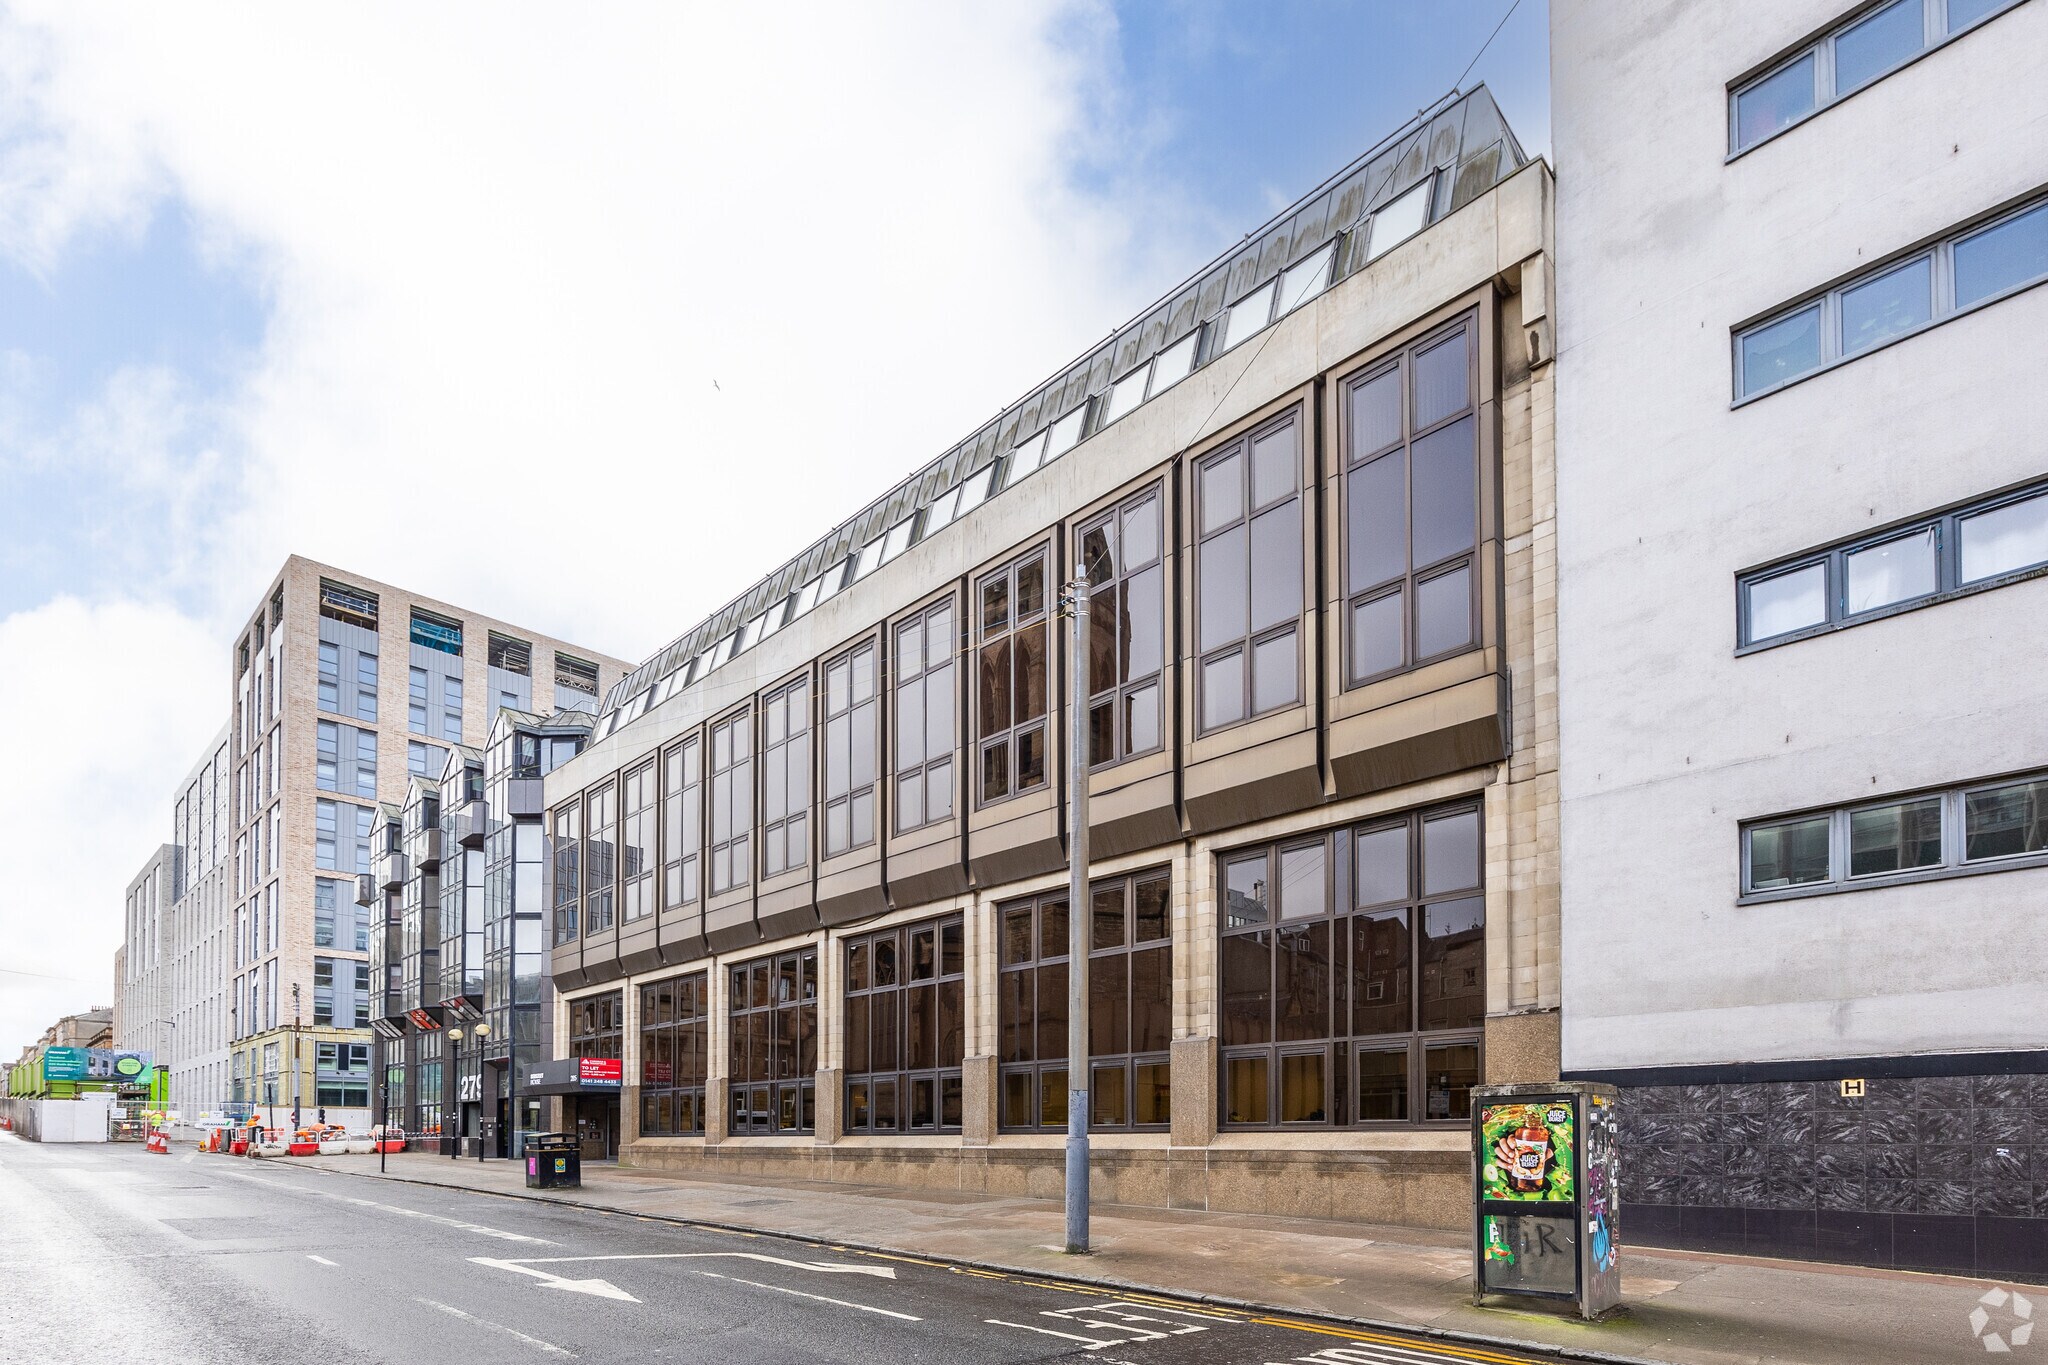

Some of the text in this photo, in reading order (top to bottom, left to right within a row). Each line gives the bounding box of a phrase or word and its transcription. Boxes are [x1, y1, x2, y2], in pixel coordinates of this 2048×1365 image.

[1845, 1081, 1861, 1094] H
[1547, 1109, 1566, 1117] JUICE
[1520, 1154, 1539, 1162] JUICE
